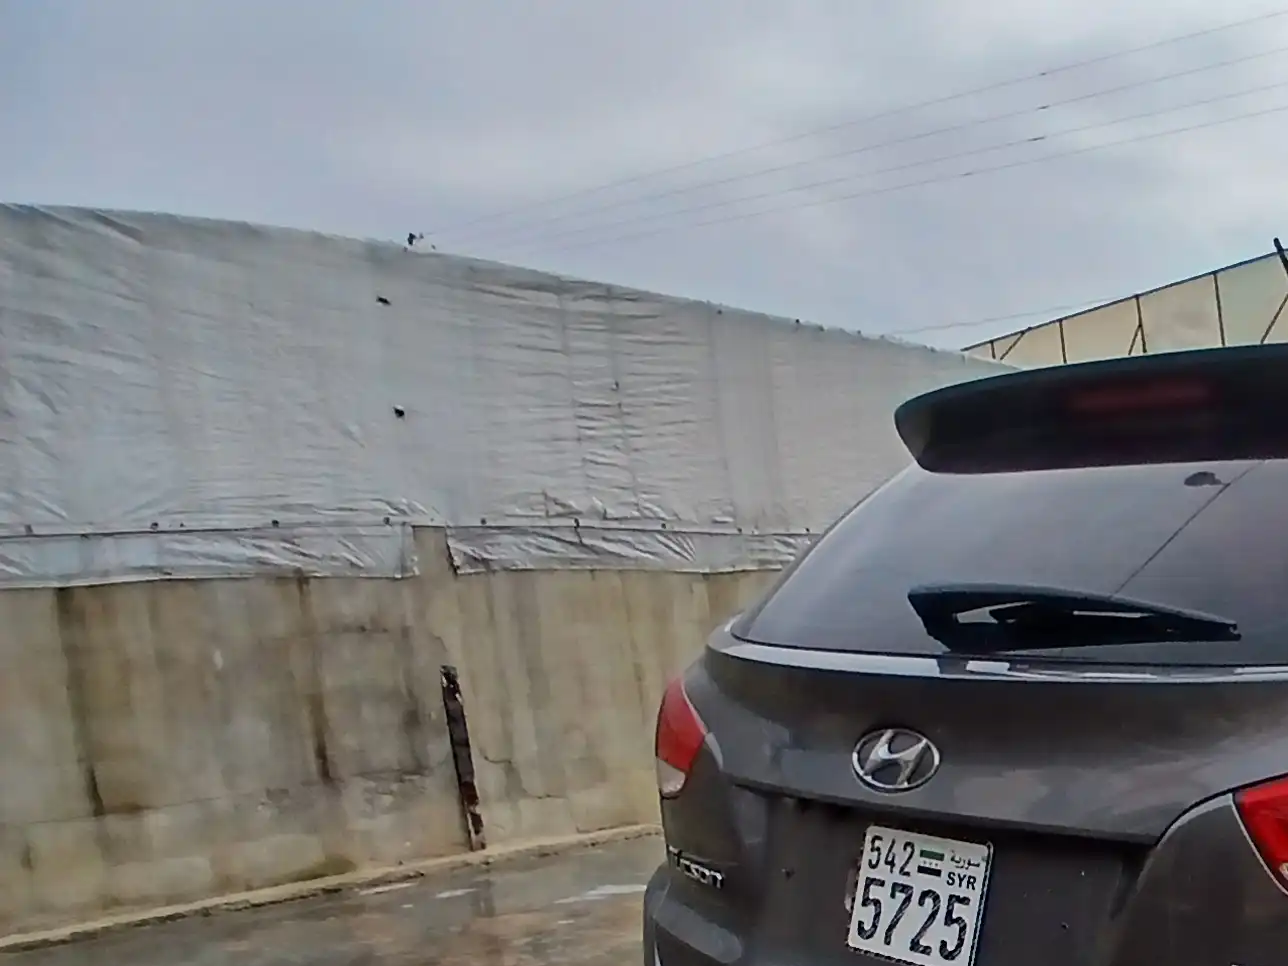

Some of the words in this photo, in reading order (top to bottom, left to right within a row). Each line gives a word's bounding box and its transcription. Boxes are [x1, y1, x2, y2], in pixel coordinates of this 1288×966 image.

[868, 835, 915, 877] 542
[946, 872, 977, 890] SYR
[857, 876, 970, 961] 5725
